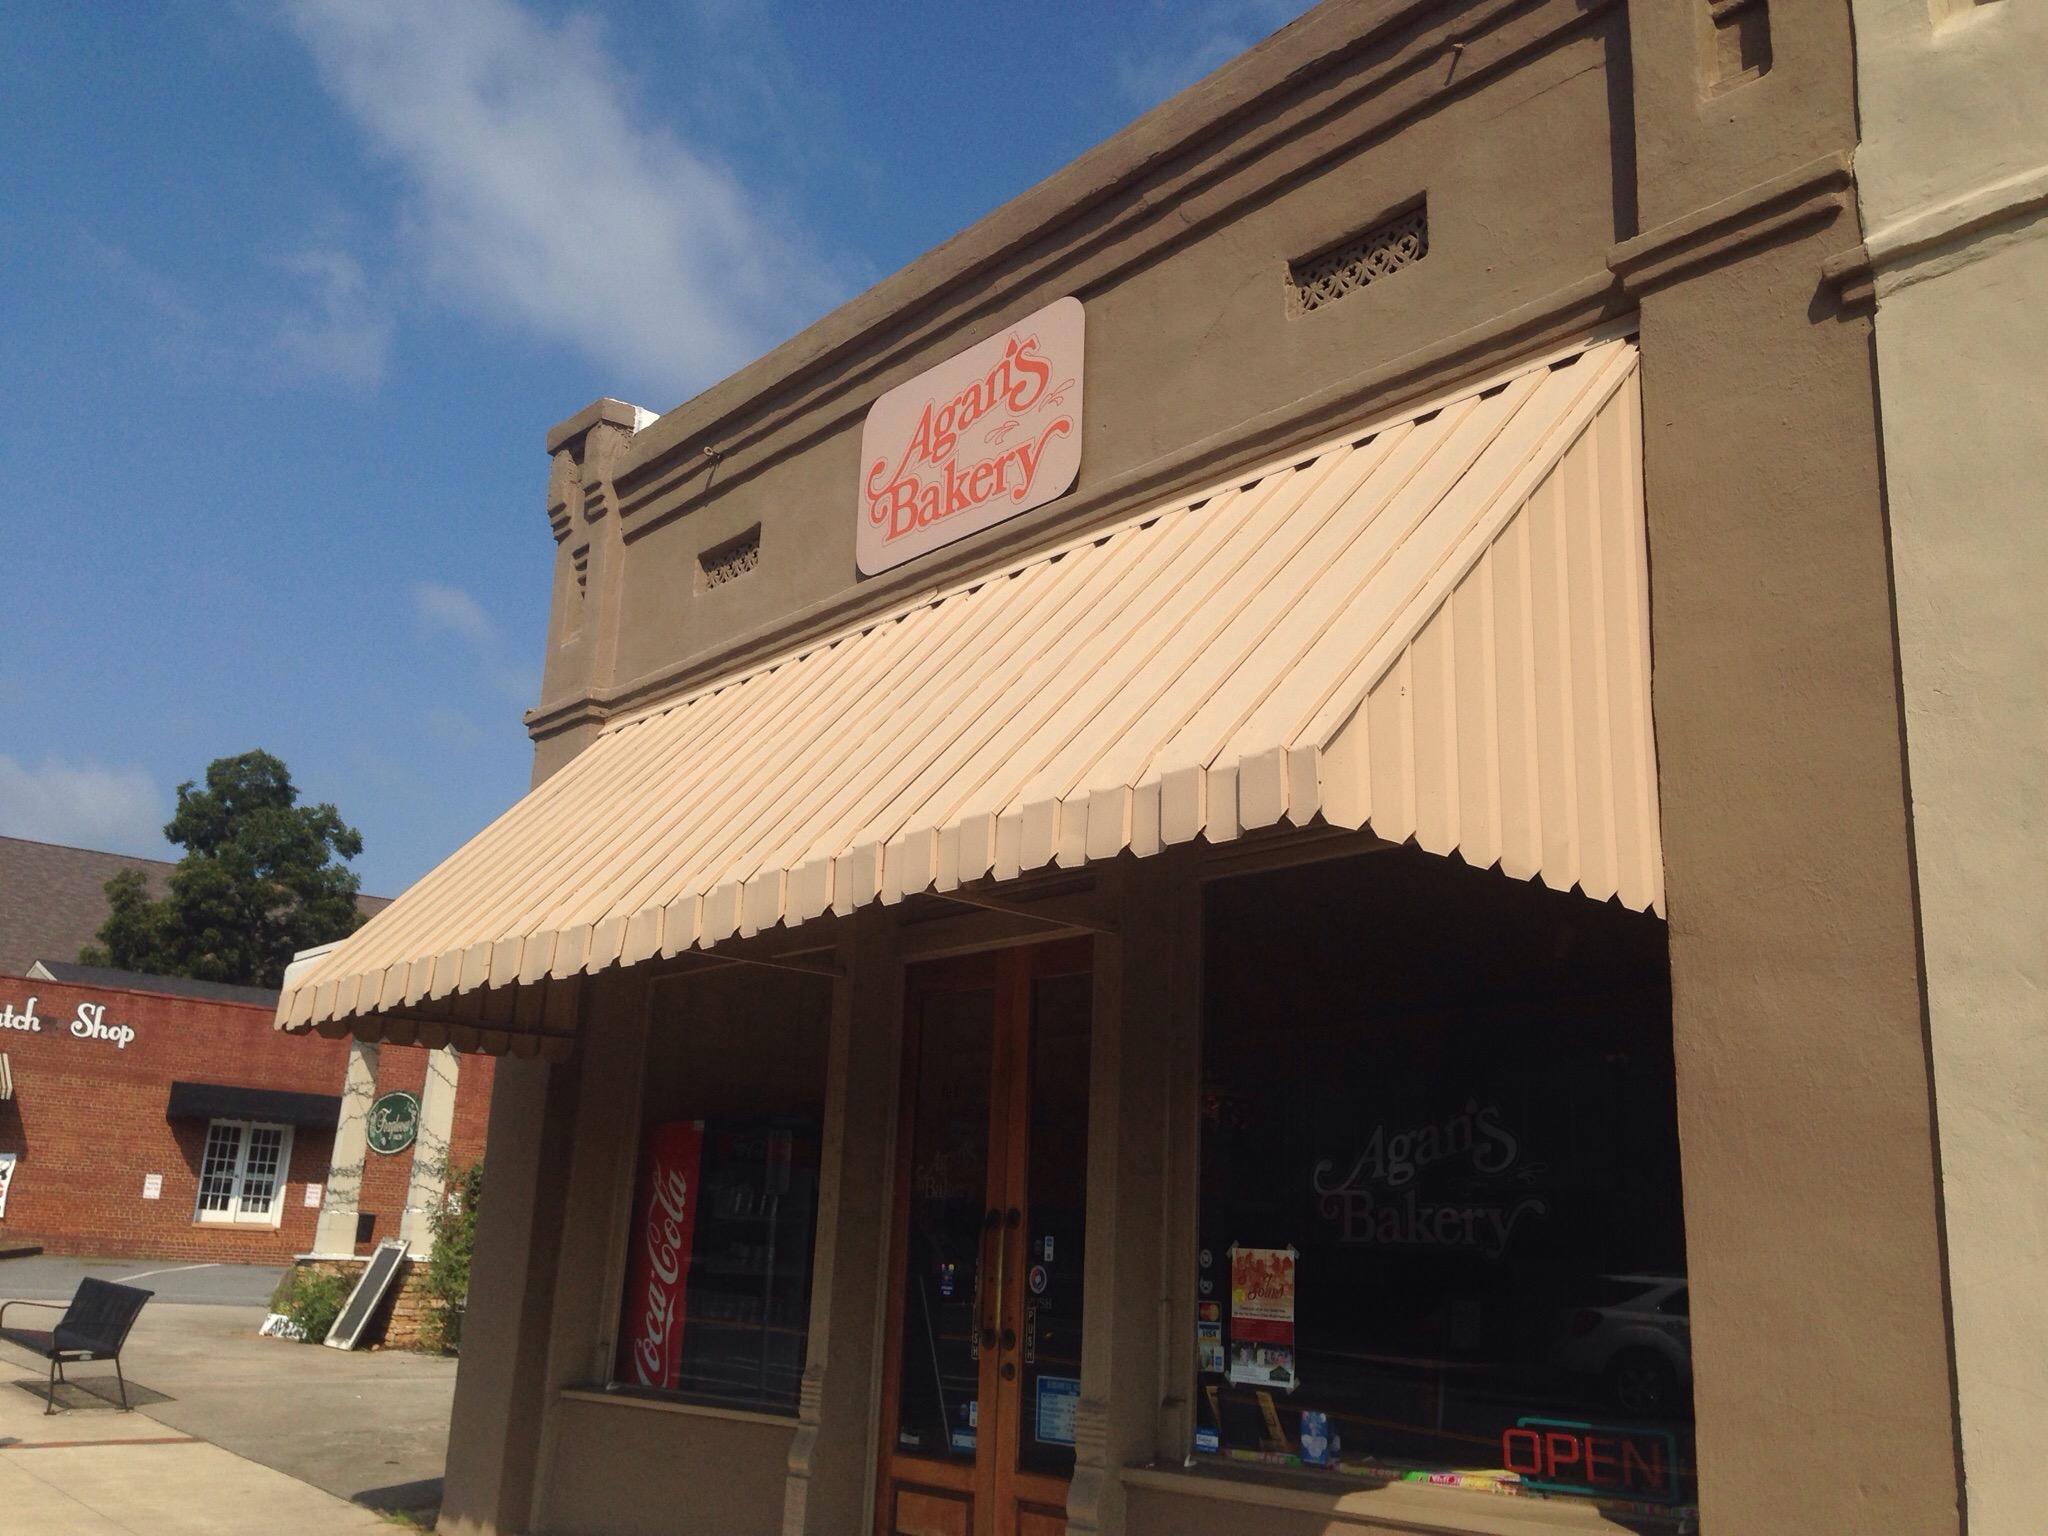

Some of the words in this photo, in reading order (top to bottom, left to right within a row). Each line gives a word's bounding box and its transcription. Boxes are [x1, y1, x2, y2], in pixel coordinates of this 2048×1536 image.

[871, 419, 1072, 541] Bakery
[70, 1002, 135, 1049] Shop
[1319, 1189, 1547, 1260] Bakery
[1026, 1310, 1035, 1361] PUSH
[1503, 1428, 1664, 1489] OPEN
